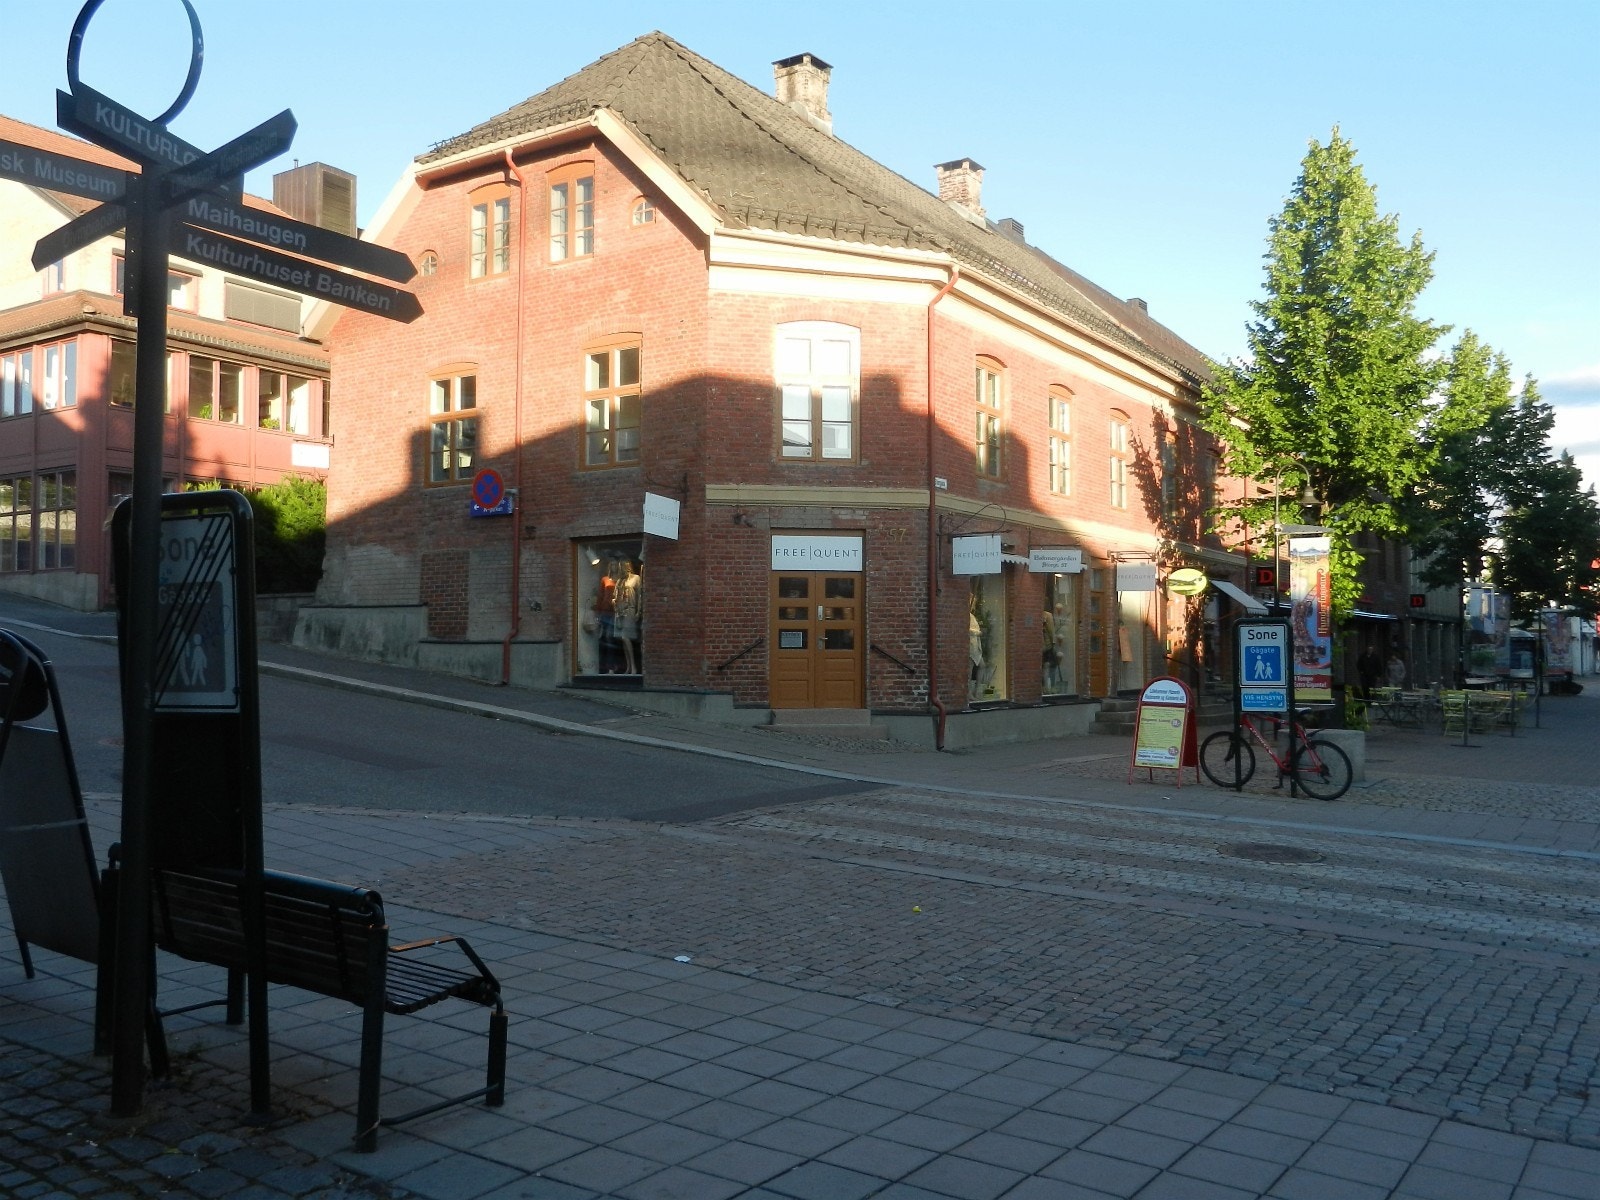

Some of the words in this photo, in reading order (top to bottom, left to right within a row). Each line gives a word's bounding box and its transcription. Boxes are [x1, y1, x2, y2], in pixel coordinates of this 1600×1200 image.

[33, 156, 118, 196] Museum
[188, 197, 307, 248] Maihaugen
[186, 233, 312, 288] Kulturhuset
[316, 272, 392, 310] Banken
[889, 527, 907, 544] 57
[1259, 569, 1273, 584] D
[1412, 597, 1423, 606] D
[1247, 629, 1278, 641] Sone
[1250, 646, 1276, 655] Gågate
